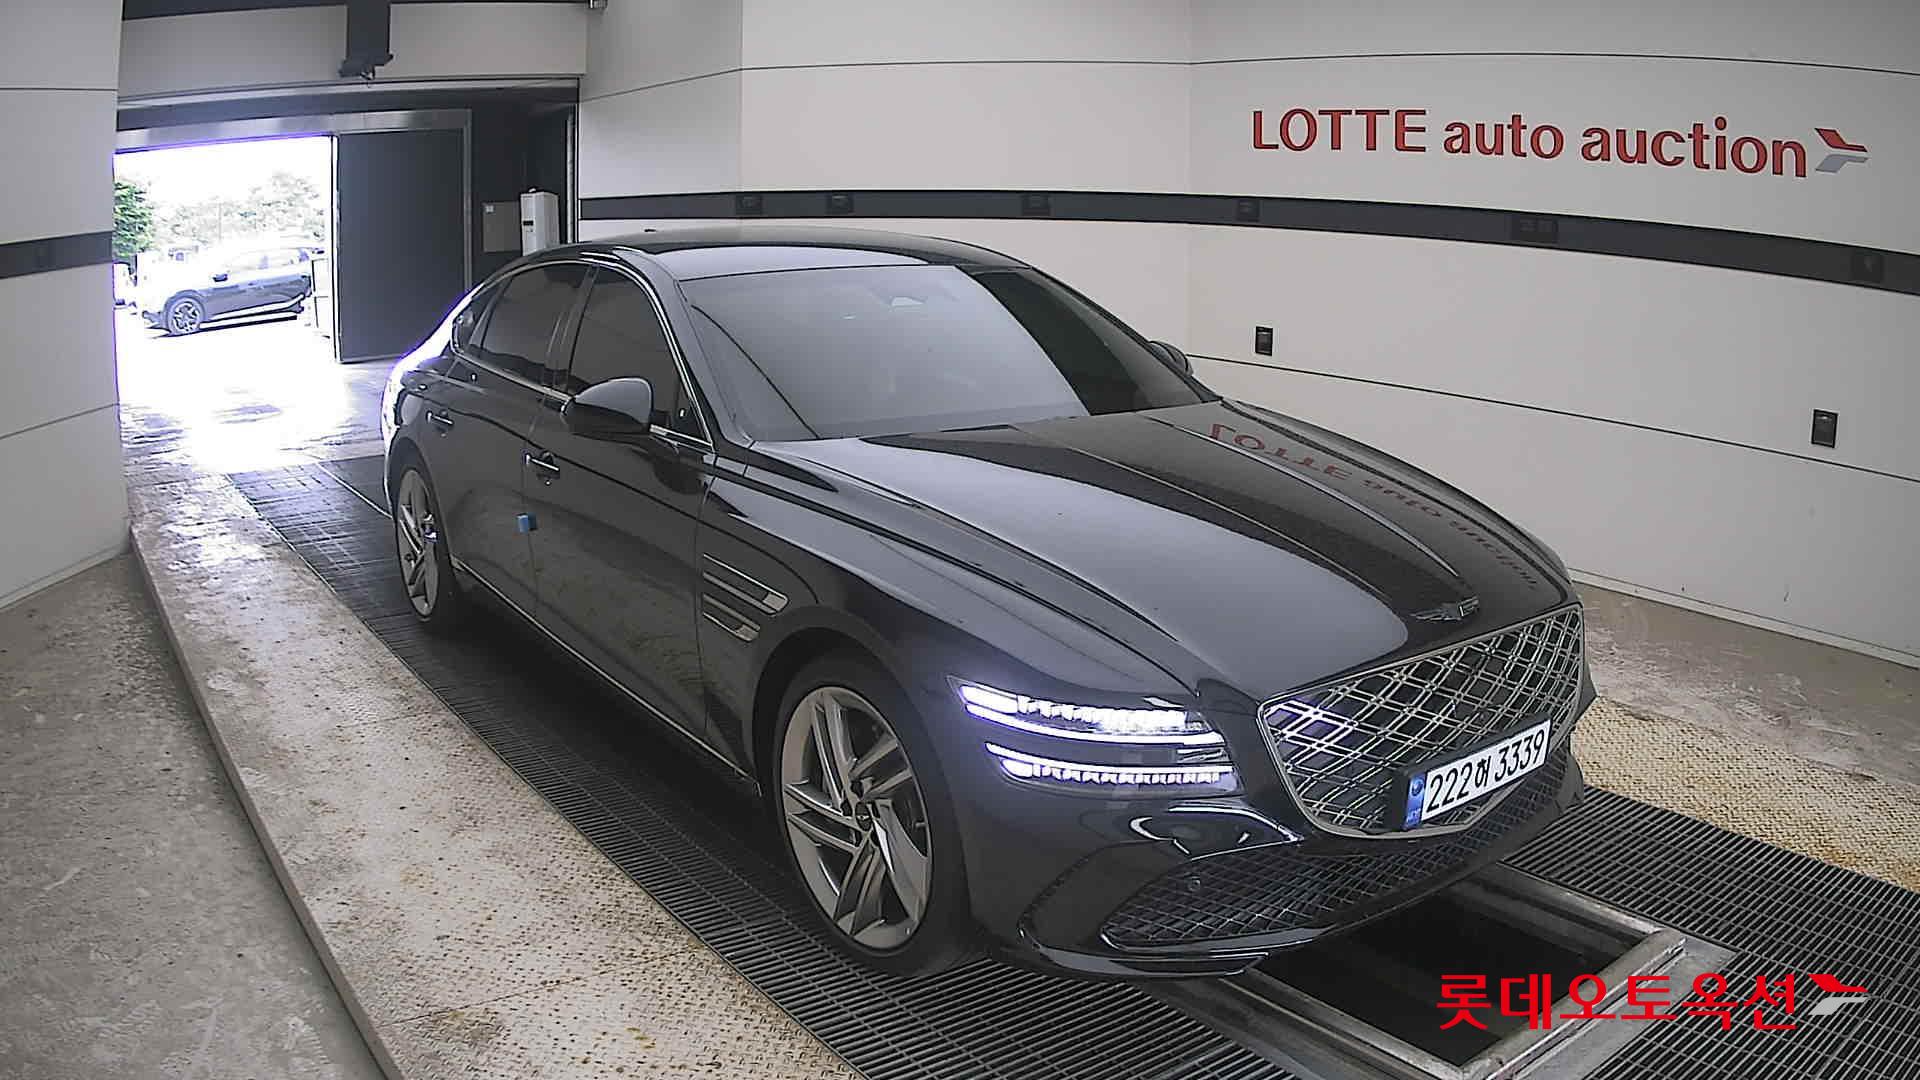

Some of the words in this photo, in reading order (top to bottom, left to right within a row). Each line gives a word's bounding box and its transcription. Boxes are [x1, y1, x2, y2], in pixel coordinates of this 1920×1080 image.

[1250, 108, 1427, 153] LOTTE
[1443, 114, 1565, 160] auto
[1580, 116, 1807, 178] auction
[1426, 755, 1492, 813] 222허
[1494, 729, 1545, 782] 3339
